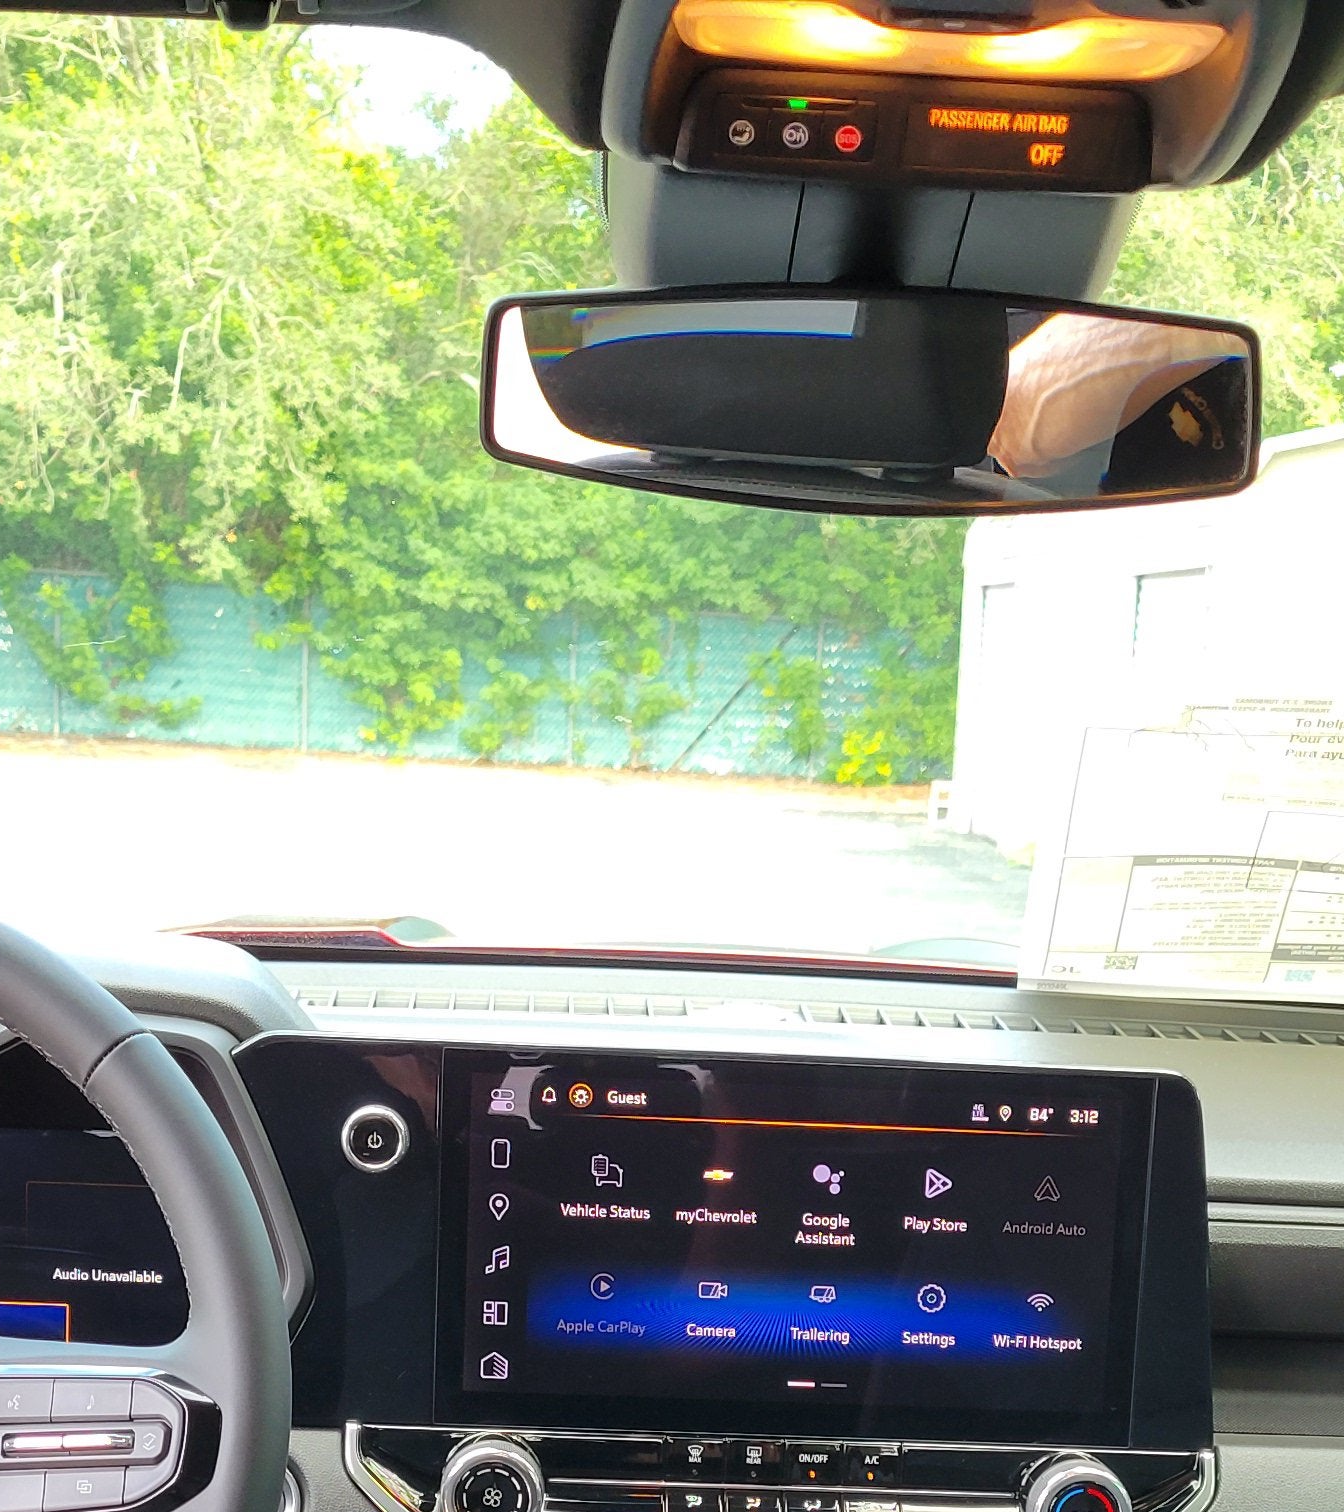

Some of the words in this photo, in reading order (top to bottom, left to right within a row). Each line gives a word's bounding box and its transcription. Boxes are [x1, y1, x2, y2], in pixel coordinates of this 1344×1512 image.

[930, 107, 1012, 131] PASSENGER
[1013, 113, 1037, 132] AIR
[1038, 114, 1070, 135] BAG
[840, 133, 857, 143] SOS
[1029, 142, 1065, 166] OFF
[1296, 718, 1312, 729] To
[1290, 735, 1323, 744] Pour
[1286, 748, 1317, 758] Para
[607, 1090, 647, 1105] Guest
[1070, 1109, 1098, 1124] 3:12
[560, 1203, 607, 1218] Vehicle
[609, 1205, 651, 1219] Status
[675, 1208, 757, 1225] myChevrolet
[802, 1212, 850, 1229] Google
[904, 1216, 931, 1233] Play
[932, 1218, 967, 1232] Store
[1002, 1221, 1053, 1235] Android
[1056, 1223, 1086, 1236] Auto
[795, 1231, 855, 1246] Assistant
[52, 1267, 89, 1280] Audio
[91, 1269, 163, 1284] Unavailable
[557, 1319, 594, 1334] Apple
[597, 1321, 646, 1337] CarPlay
[686, 1323, 736, 1338] Camera
[790, 1326, 850, 1344] Trailering
[902, 1331, 955, 1348] Settings
[993, 1334, 1027, 1348] Wi-Fi
[1030, 1335, 1082, 1351] Hotspot
[798, 1453, 829, 1464] ON/OFF
[864, 1455, 880, 1465] A/C
